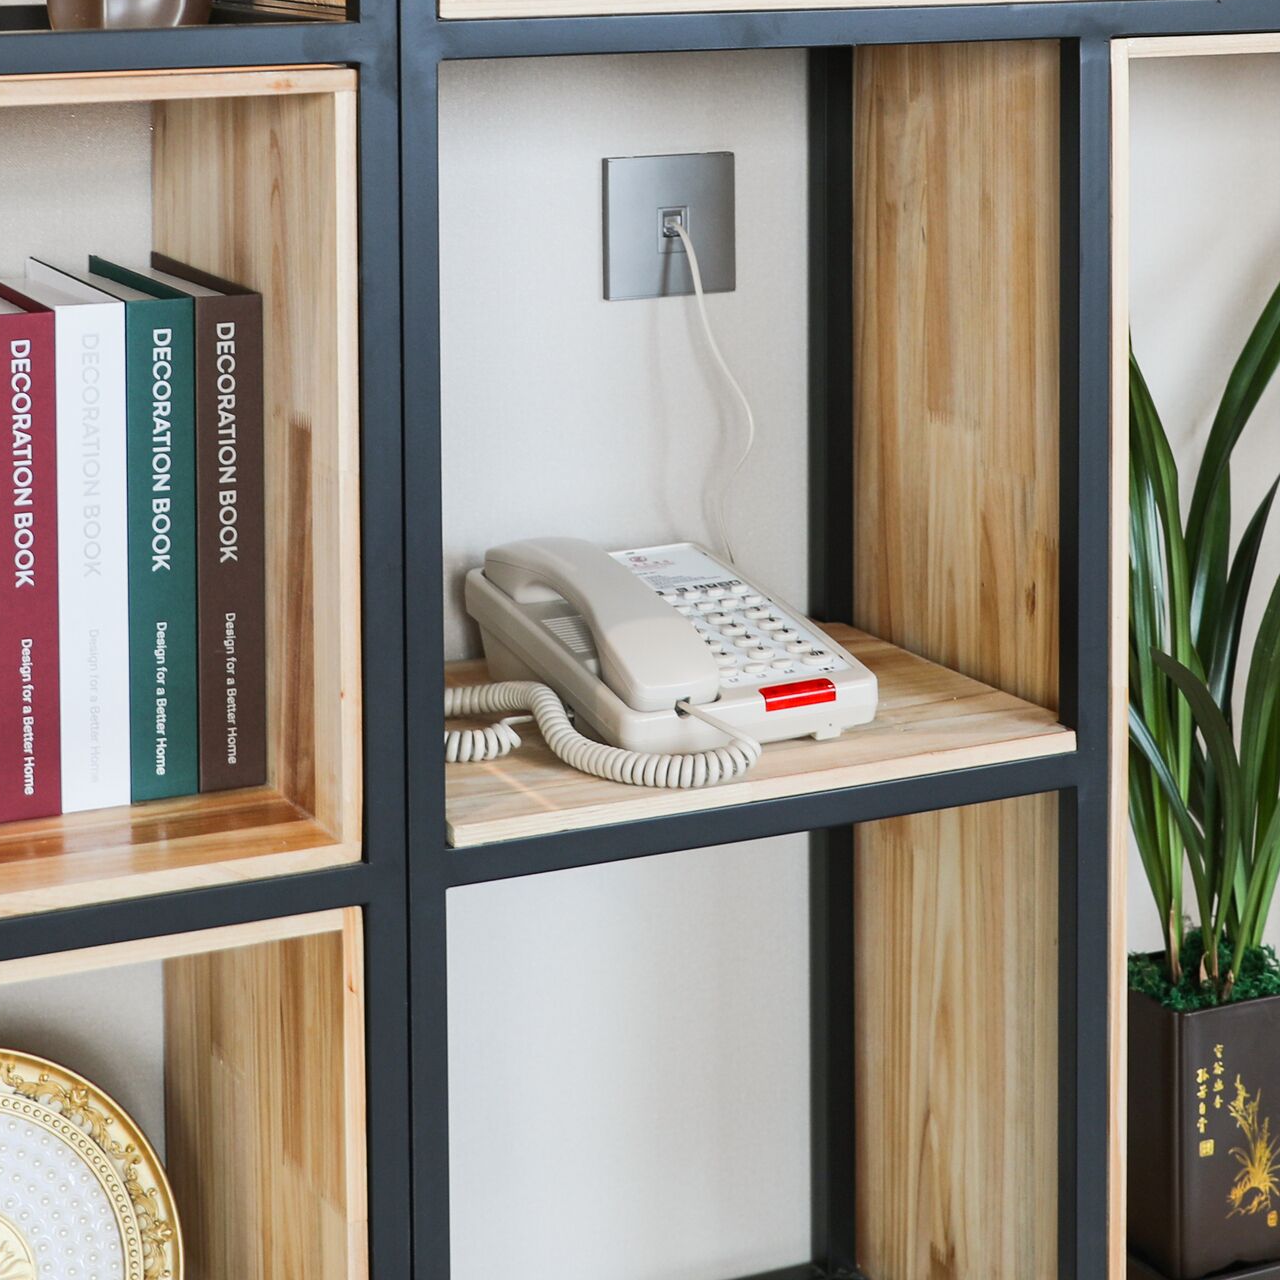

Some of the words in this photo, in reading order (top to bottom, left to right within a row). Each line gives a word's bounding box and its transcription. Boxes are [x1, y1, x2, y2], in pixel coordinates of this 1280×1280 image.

[81, 333, 101, 497] DECORATION
[152, 328, 172, 492] DECORATION
[216, 321, 237, 484] DECORATION
[10, 339, 33, 507] DECORATION
[83, 504, 102, 578] BOOK
[151, 497, 171, 572] BOOK
[218, 489, 238, 564] BOOK
[14, 512, 35, 588] BOOK
[86, 628, 99, 672] Design
[153, 621, 168, 665] Design
[223, 612, 237, 654] Design
[19, 638, 33, 682] Design
[156, 666, 169, 685] for
[225, 656, 238, 675] for
[22, 684, 35, 703] for
[89, 673, 101, 692] for
[156, 687, 166, 696] a
[226, 677, 235, 685] a
[22, 705, 32, 714] a
[89, 705, 101, 744] Better
[156, 698, 168, 736] Better
[226, 687, 238, 725] Better
[22, 716, 35, 754] Better
[227, 726, 238, 765] Home
[23, 756, 35, 796] Home
[90, 746, 101, 784] Home
[156, 737, 168, 776] Home
